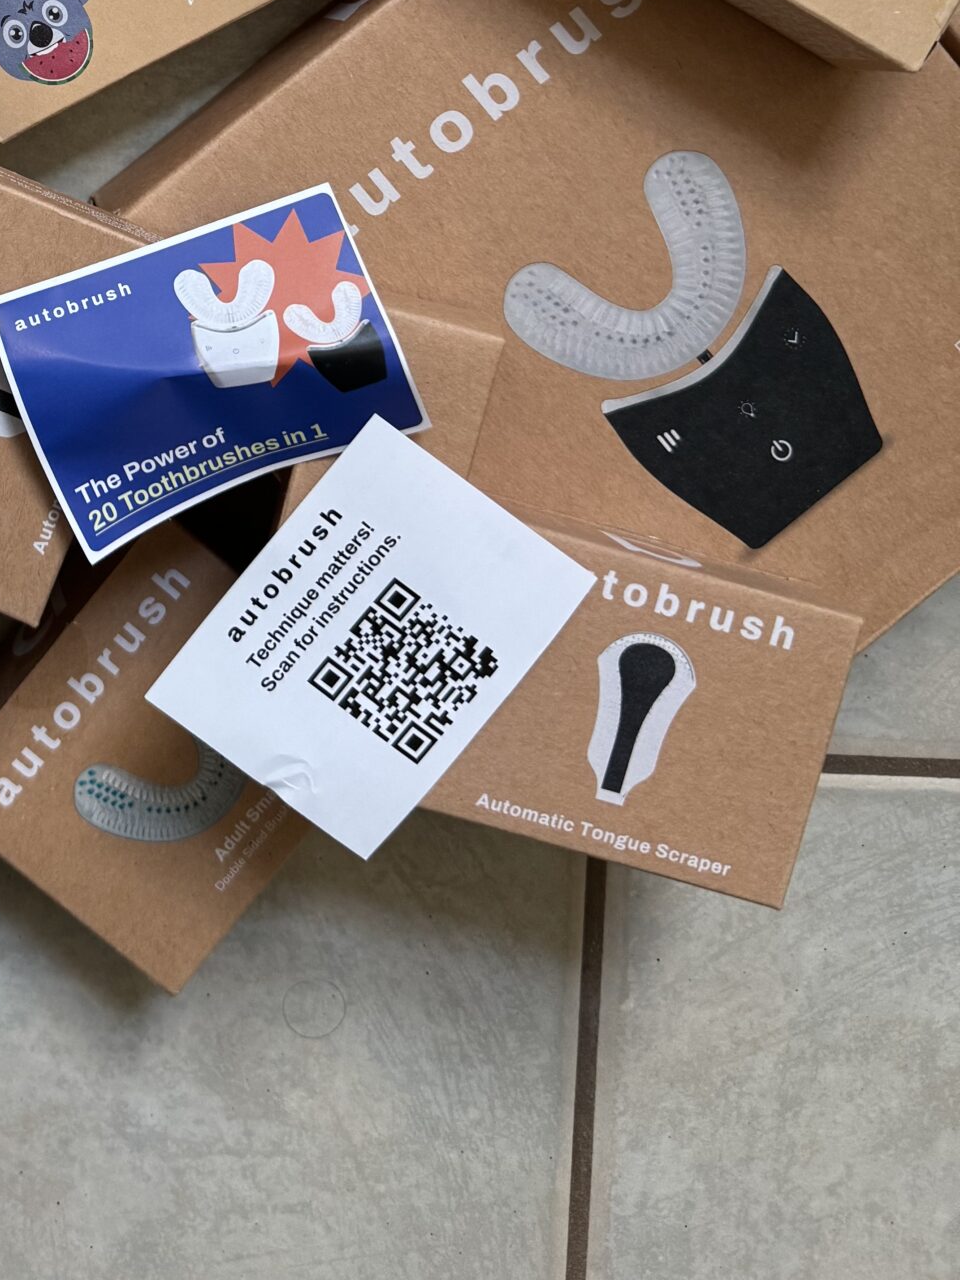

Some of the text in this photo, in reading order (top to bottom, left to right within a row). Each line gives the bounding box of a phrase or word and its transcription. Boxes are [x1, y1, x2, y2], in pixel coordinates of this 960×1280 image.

[13, 280, 133, 333] autobrush
[73, 426, 227, 506] The Power of
[87, 421, 329, 533] 20 Toothbrushes in 1
[226, 505, 344, 645] autobrush
[244, 520, 377, 671] Technique matters!
[259, 532, 402, 693] Scan for instructions.
[600, 569, 796, 651] tobrush
[213, 819, 251, 863] Adult
[213, 856, 247, 892] Double
[474, 792, 732, 877] Automatic Tongue Scraper
